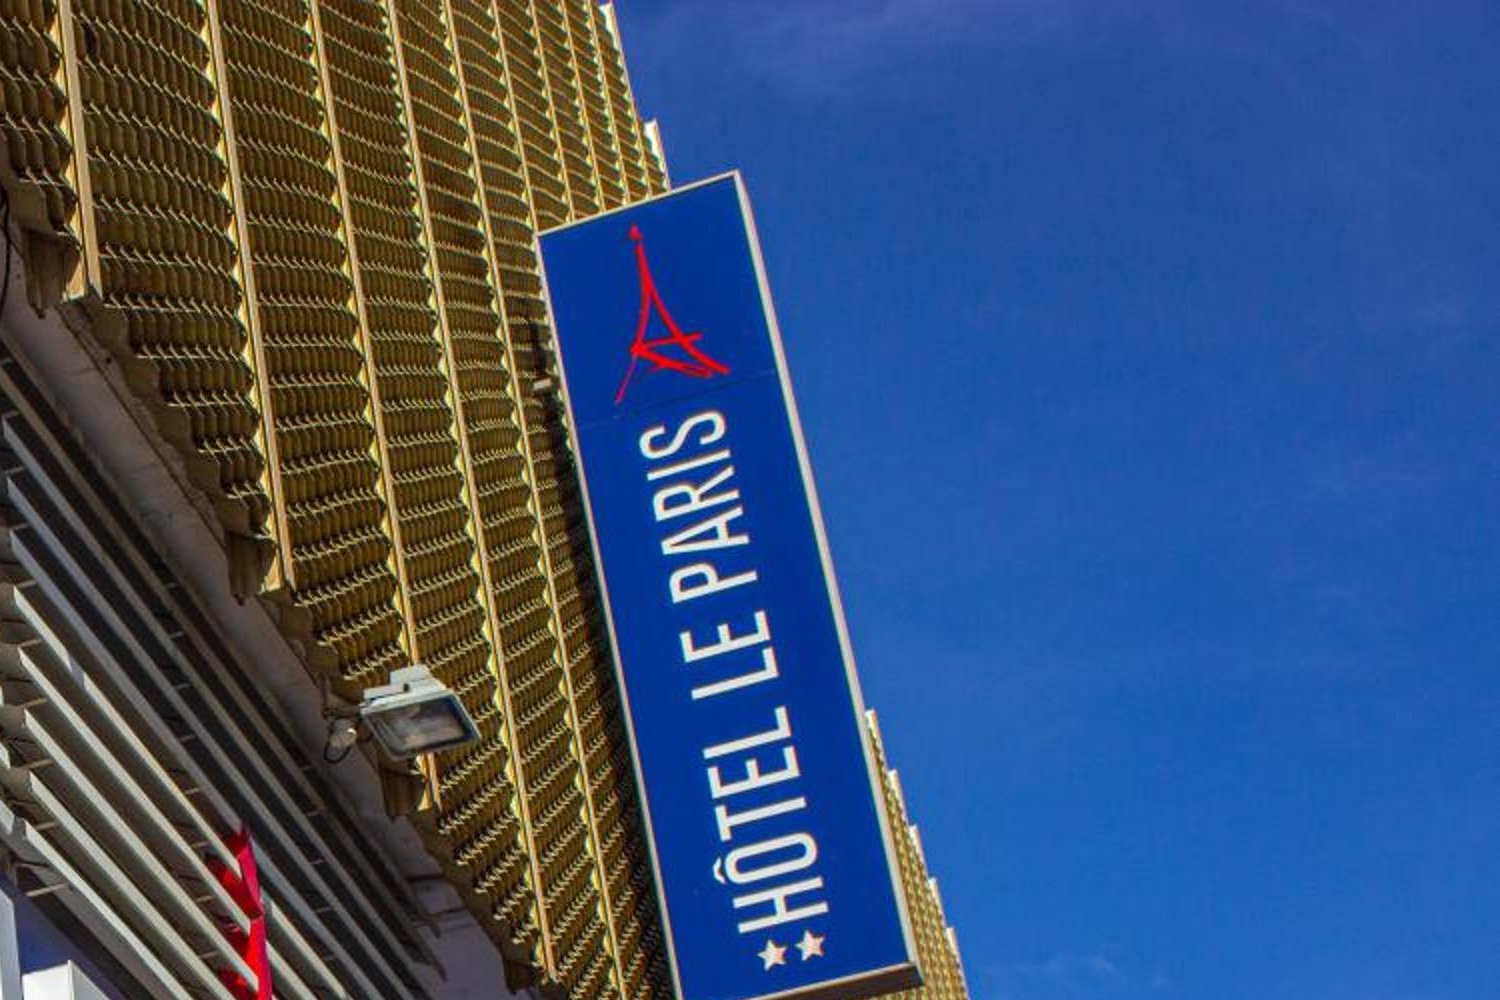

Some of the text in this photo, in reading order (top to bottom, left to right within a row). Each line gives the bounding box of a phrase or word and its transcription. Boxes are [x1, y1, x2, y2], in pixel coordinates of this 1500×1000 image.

[638, 408, 829, 934] HÔTEL LE PARIS
